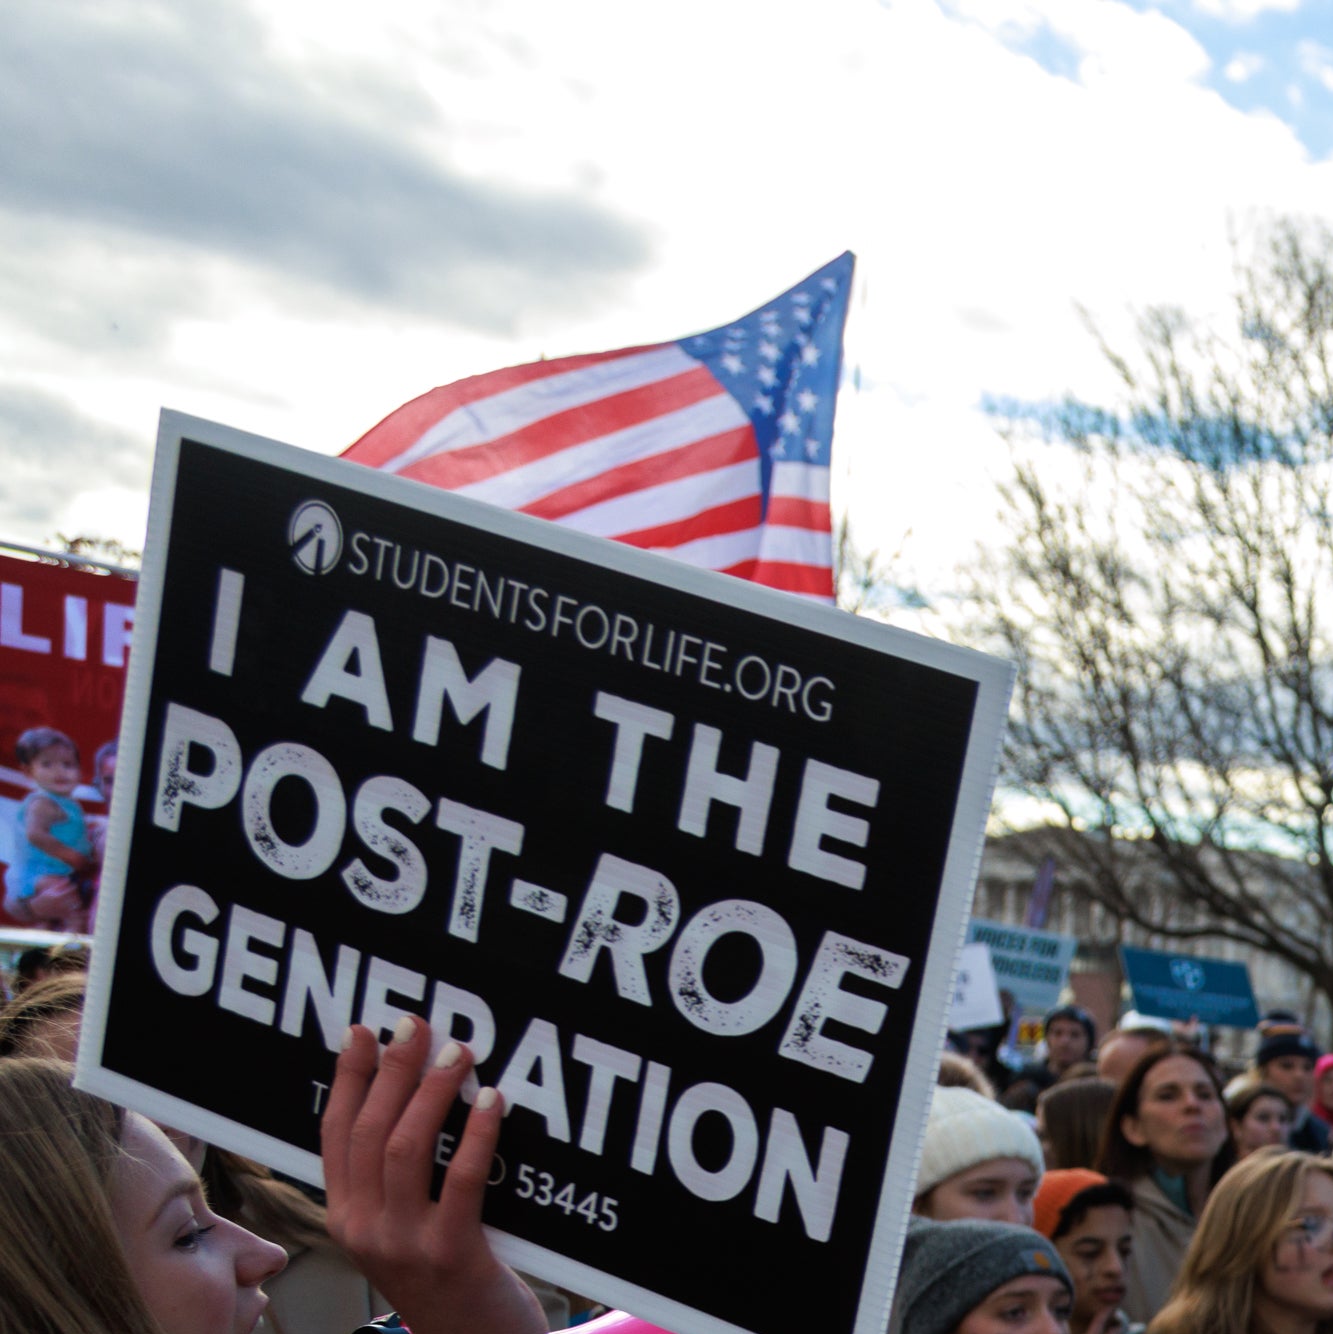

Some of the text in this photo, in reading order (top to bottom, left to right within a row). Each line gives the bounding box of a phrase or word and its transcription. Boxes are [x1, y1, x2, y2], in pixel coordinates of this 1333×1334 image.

[209, 569, 881, 891] I AM THE
[348, 532, 835, 722] STUDENTSFORLIFE.ORG
[153, 703, 911, 1084] POST-ROE
[151, 885, 850, 1243] GENERATION
[515, 1164, 619, 1232] 53445
